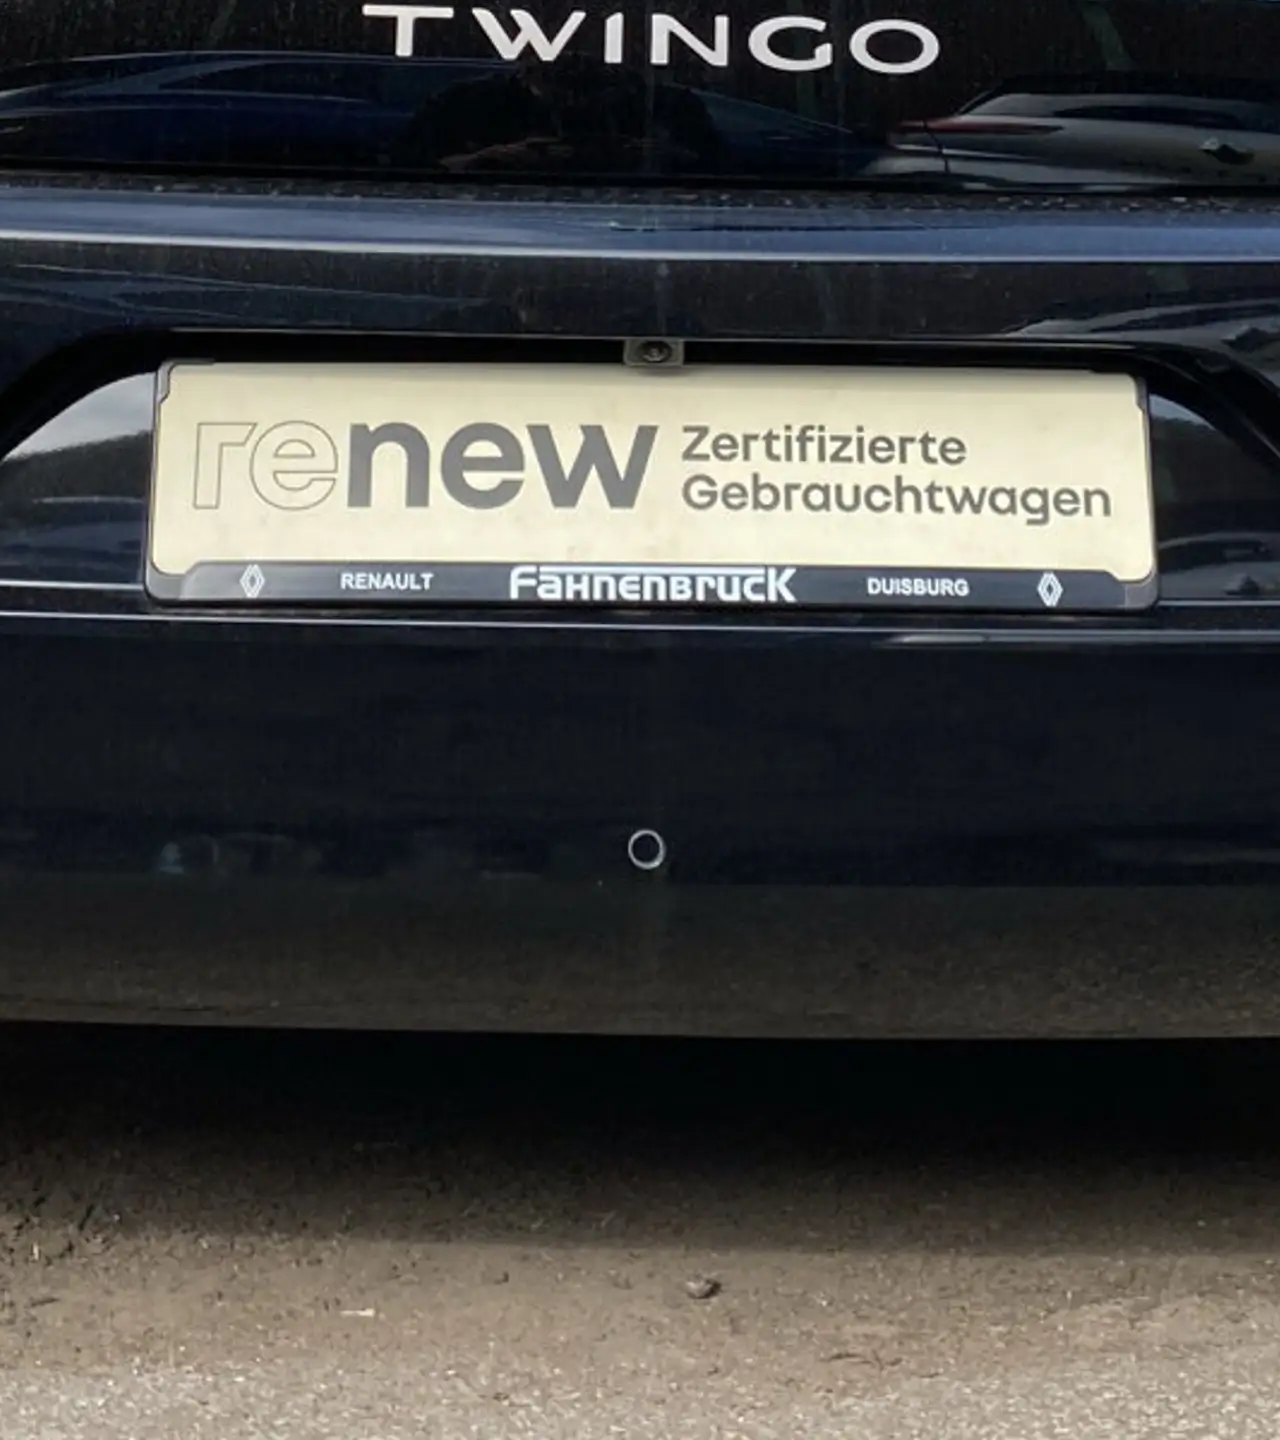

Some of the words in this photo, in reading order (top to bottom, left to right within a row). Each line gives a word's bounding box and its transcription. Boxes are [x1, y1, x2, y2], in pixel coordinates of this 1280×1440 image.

[363, 4, 939, 74] TWINGO
[193, 420, 660, 510] renew
[682, 424, 967, 465] Zertifizierte
[682, 473, 1111, 526] Gebrauchtwagen
[339, 572, 435, 591] RENAULT
[866, 576, 970, 597] DUISBURG
